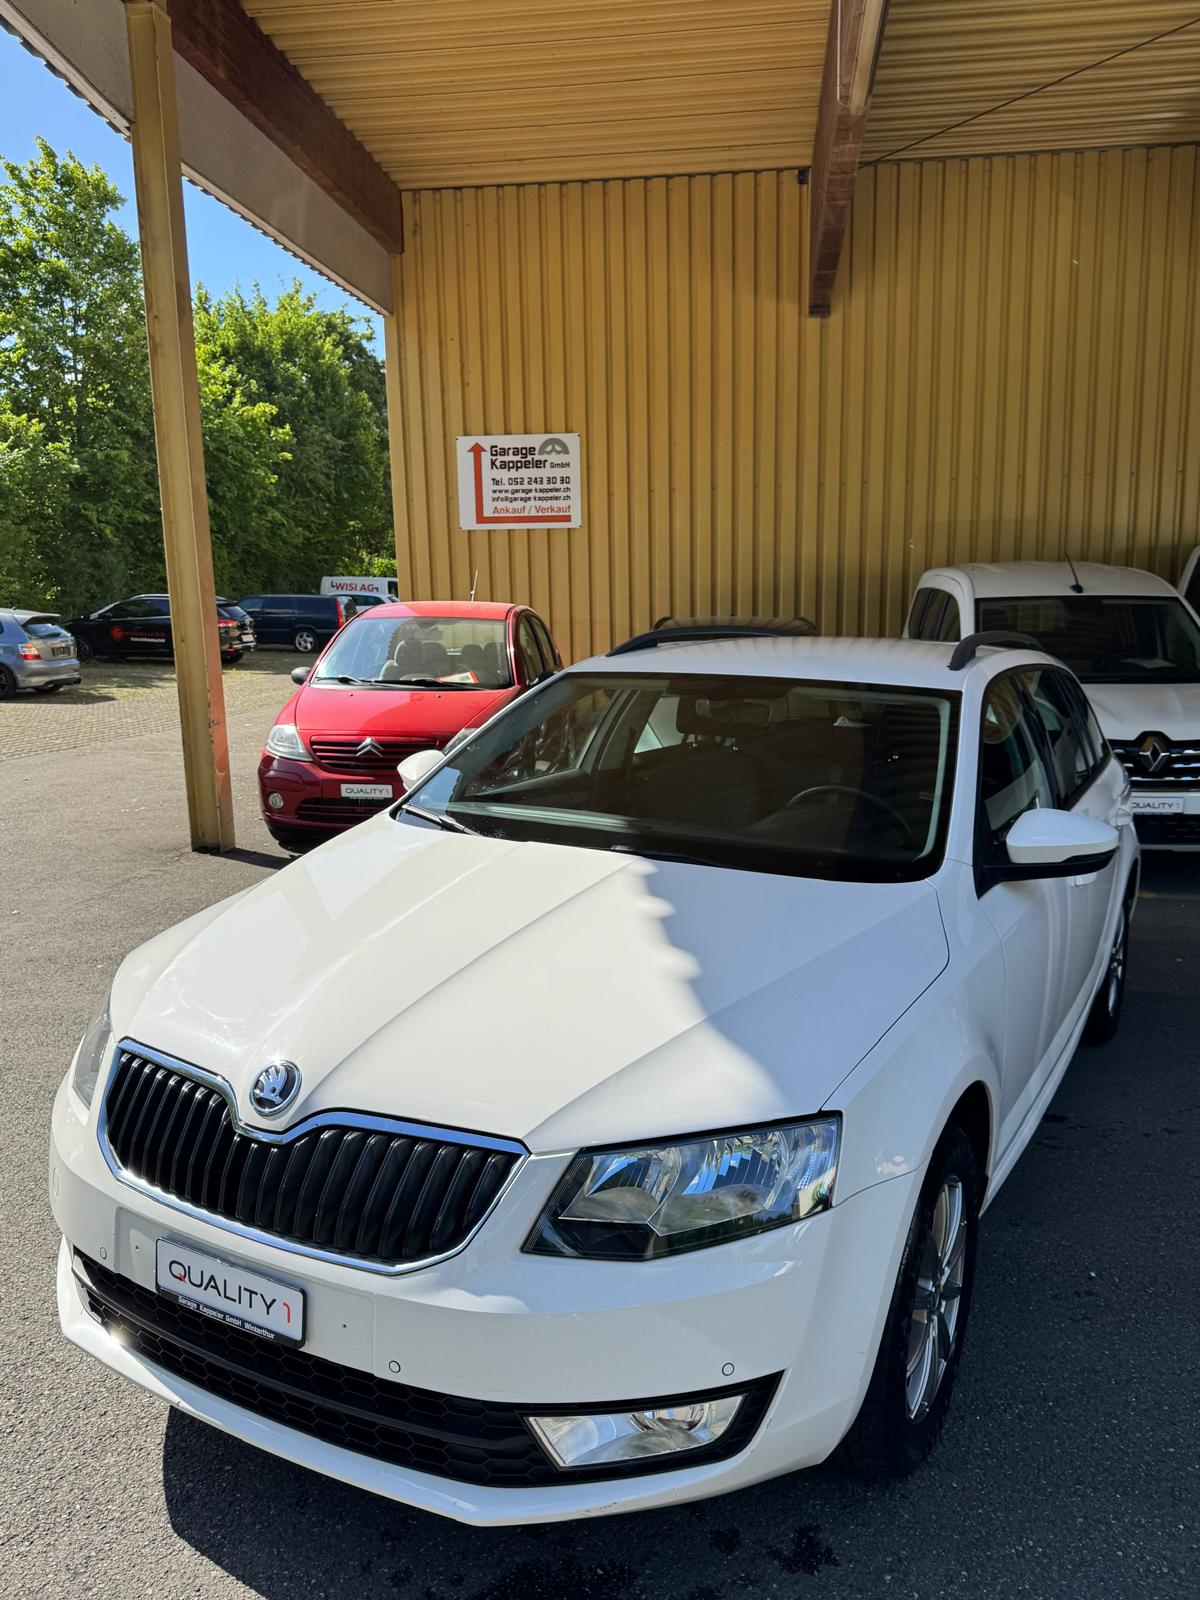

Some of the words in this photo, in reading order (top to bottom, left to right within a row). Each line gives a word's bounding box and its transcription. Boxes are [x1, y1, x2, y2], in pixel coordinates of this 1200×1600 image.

[490, 445, 536, 459] Garage
[490, 458, 548, 472] Kappeler
[491, 478, 506, 486] Tel.
[508, 477, 525, 486] 052
[527, 477, 544, 485] 243
[546, 476, 557, 485] 30
[559, 476, 571, 485] 30
[492, 505, 526, 515] Ankauf
[534, 504, 571, 514] Verkauf
[335, 582, 358, 592] WISI
[359, 583, 376, 593] AG
[168, 1260, 277, 1316] QUALITY
[178, 1295, 198, 1309] Garage
[199, 1303, 224, 1319] Kappeler
[225, 1314, 242, 1327] GmbH
[244, 1322, 275, 1340] Winterthur
